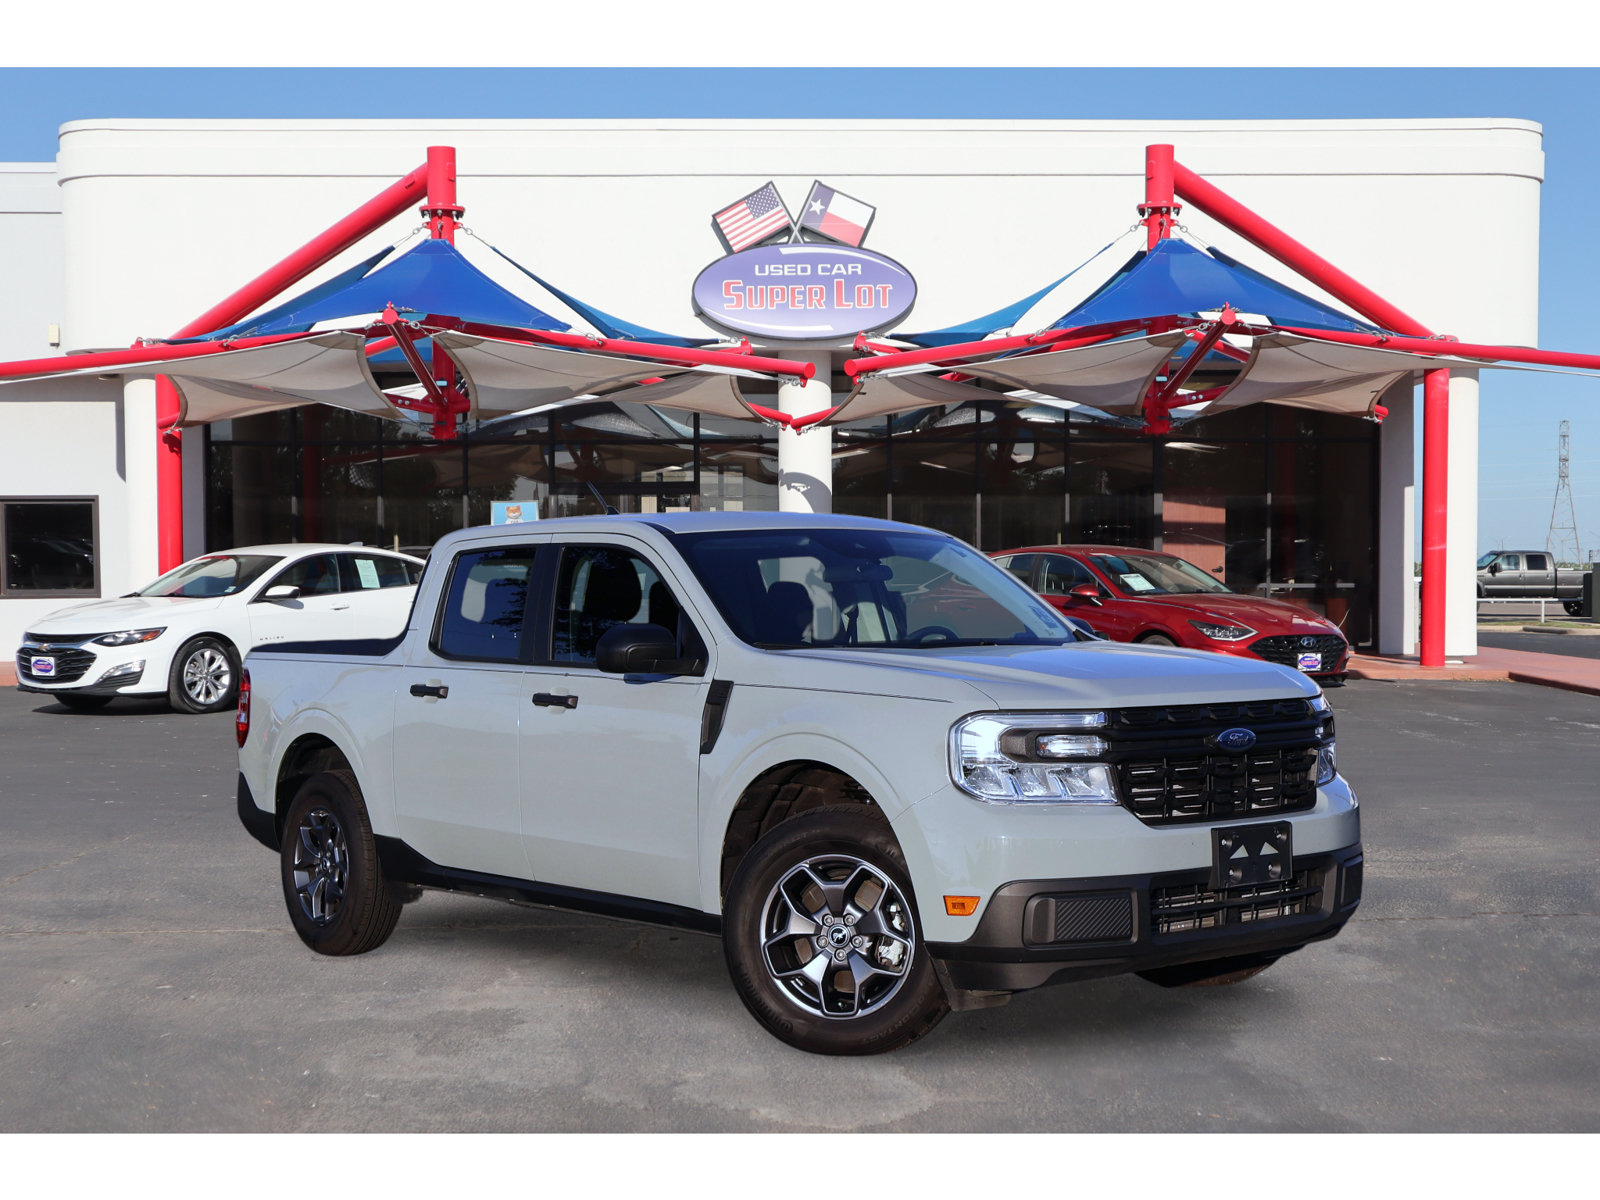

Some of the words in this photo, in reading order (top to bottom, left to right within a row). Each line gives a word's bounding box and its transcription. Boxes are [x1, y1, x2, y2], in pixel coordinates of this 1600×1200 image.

[754, 264, 811, 276] USED
[817, 263, 862, 276] CAR
[722, 279, 826, 310] SUPER
[833, 278, 893, 309] LOT
